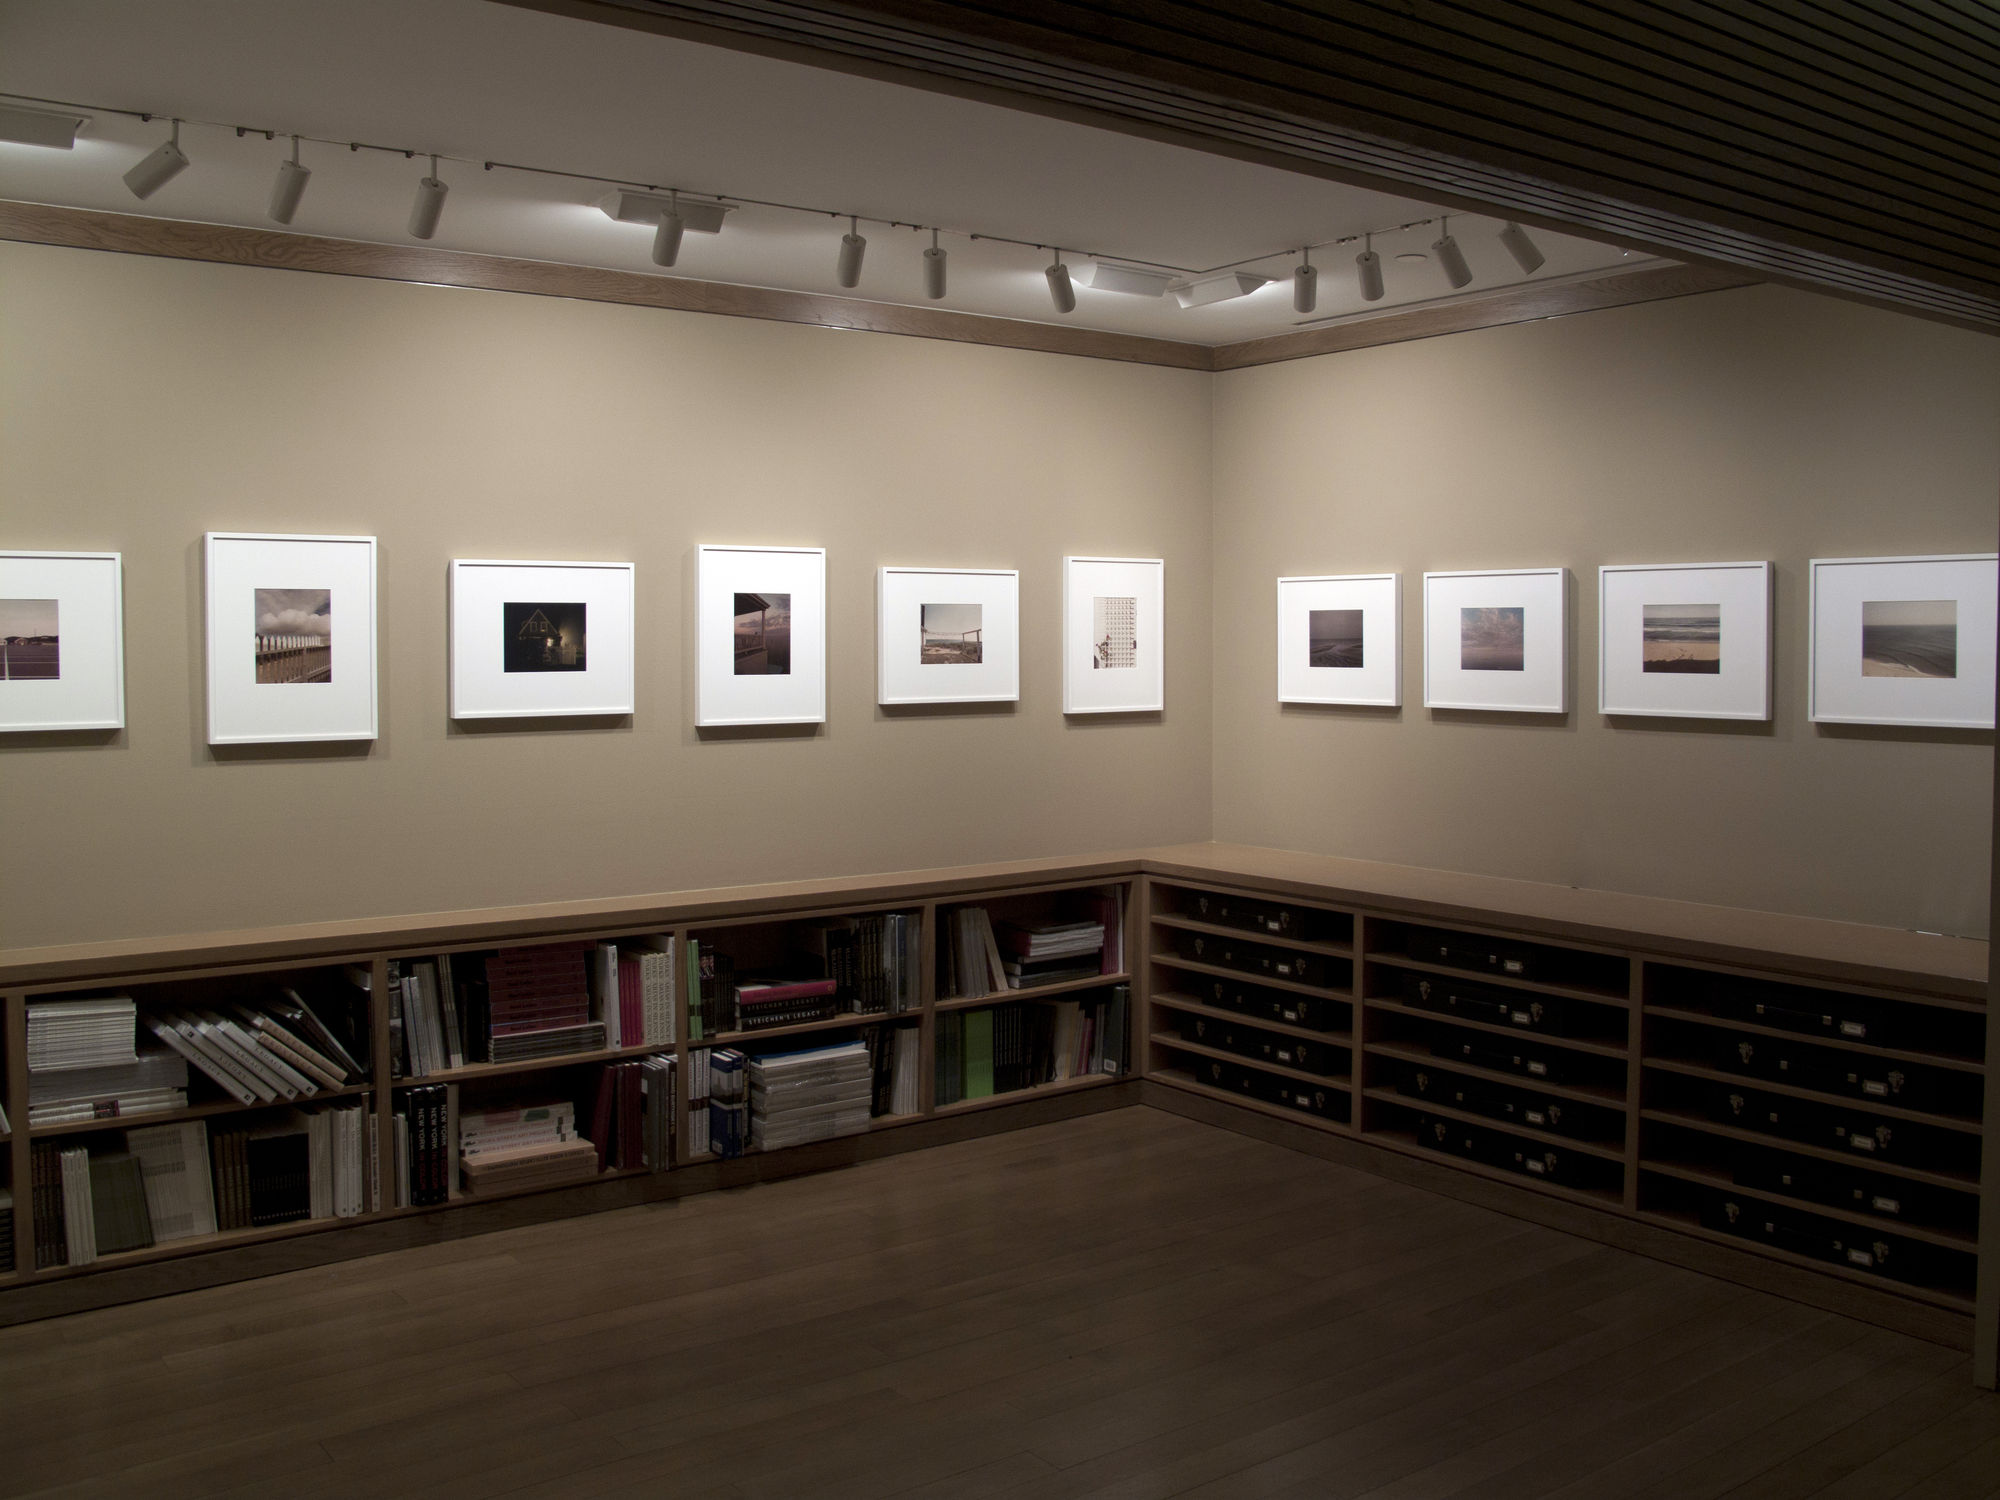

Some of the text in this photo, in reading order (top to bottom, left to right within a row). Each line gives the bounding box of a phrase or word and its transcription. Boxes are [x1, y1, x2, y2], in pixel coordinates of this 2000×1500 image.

[748, 1010, 821, 1025] STEICHEN'S LEGACY
[234, 1048, 264, 1073] LEGACY
[254, 1047, 283, 1070] LEGACY
[417, 1108, 425, 1126] NEW
[430, 1107, 438, 1126] NEW
[418, 1127, 426, 1150] YORK
